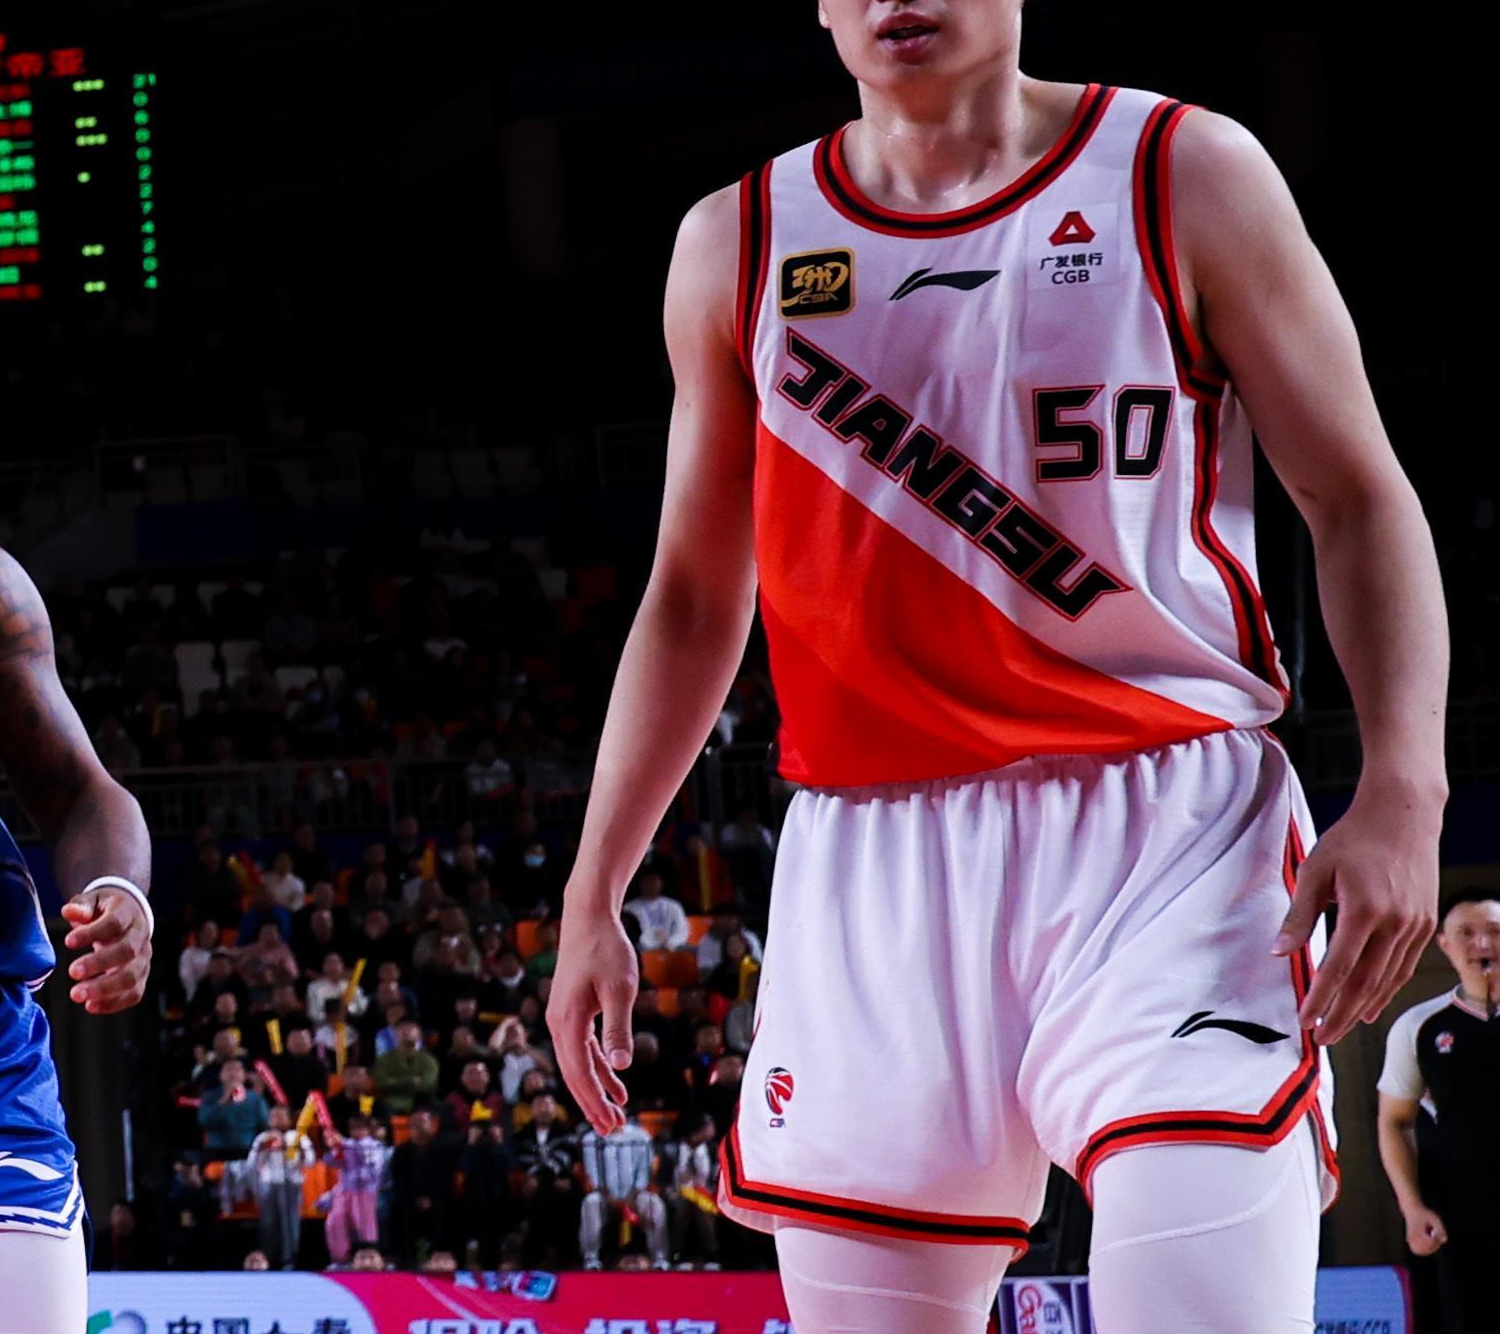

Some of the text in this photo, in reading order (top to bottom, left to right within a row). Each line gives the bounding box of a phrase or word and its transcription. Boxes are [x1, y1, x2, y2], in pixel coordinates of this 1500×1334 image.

[1040, 252, 1103, 270] 广发银行
[1051, 270, 1090, 285] CGB
[800, 292, 839, 304] CBA
[1032, 384, 1175, 483] 50
[775, 326, 1133, 622] JIANGSU
